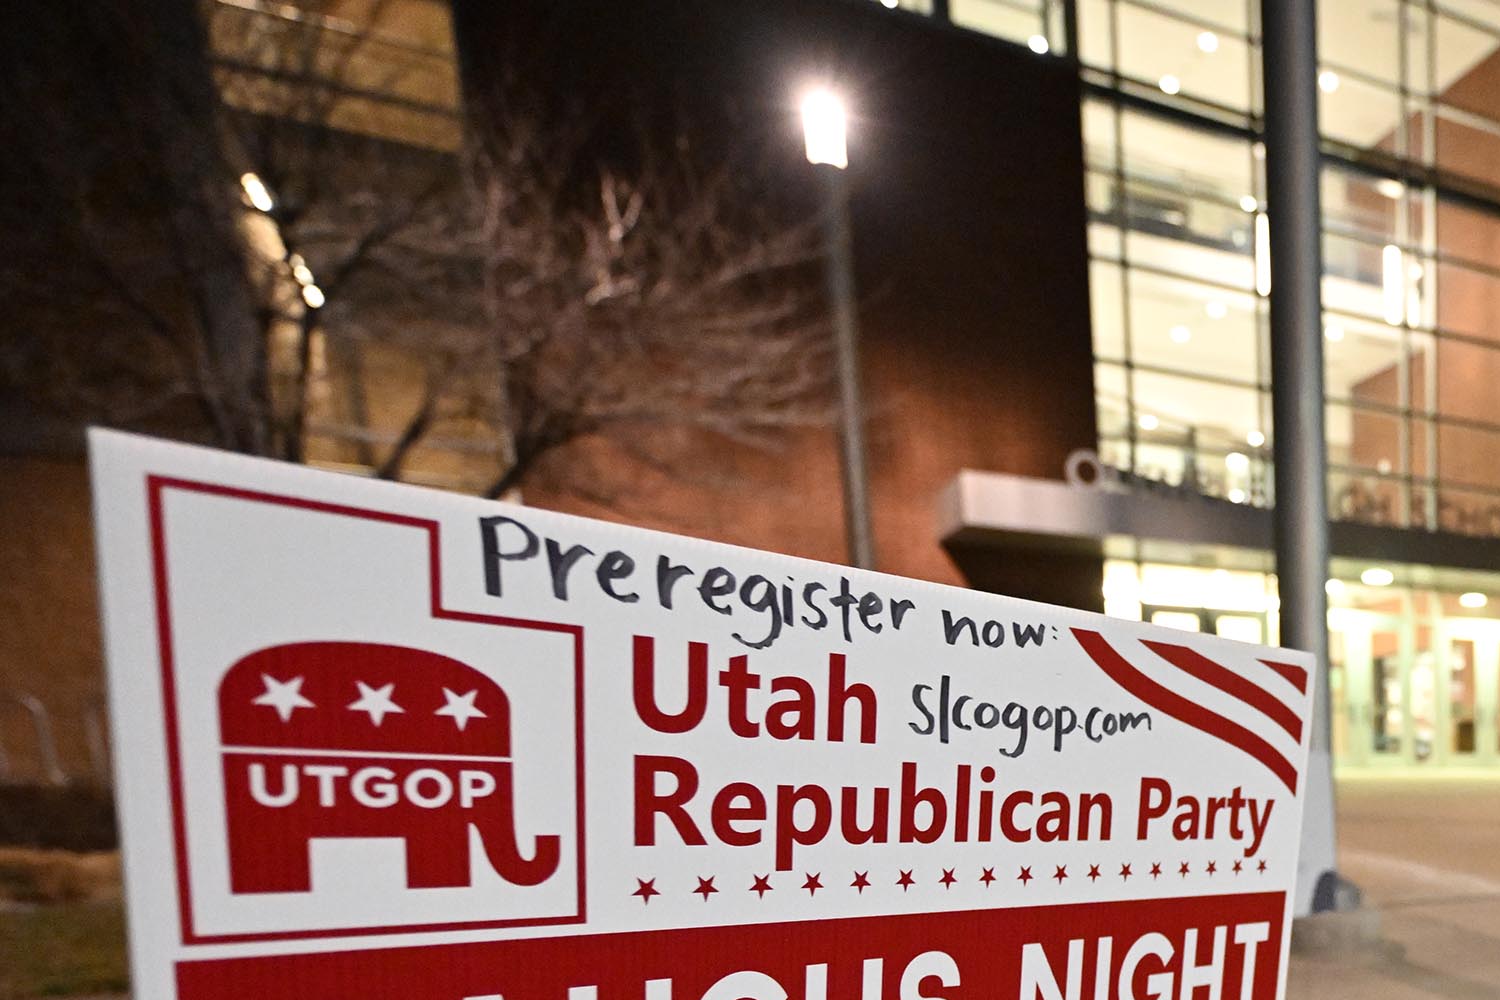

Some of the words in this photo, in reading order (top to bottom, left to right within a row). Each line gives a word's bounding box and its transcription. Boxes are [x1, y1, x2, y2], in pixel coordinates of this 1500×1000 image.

[479, 515, 916, 649] Preregister
[941, 609, 1059, 648] now:
[633, 635, 878, 745] Utah
[248, 764, 498, 809] UTGOP
[633, 754, 1114, 871] Republican
[1136, 776, 1275, 858] Party
